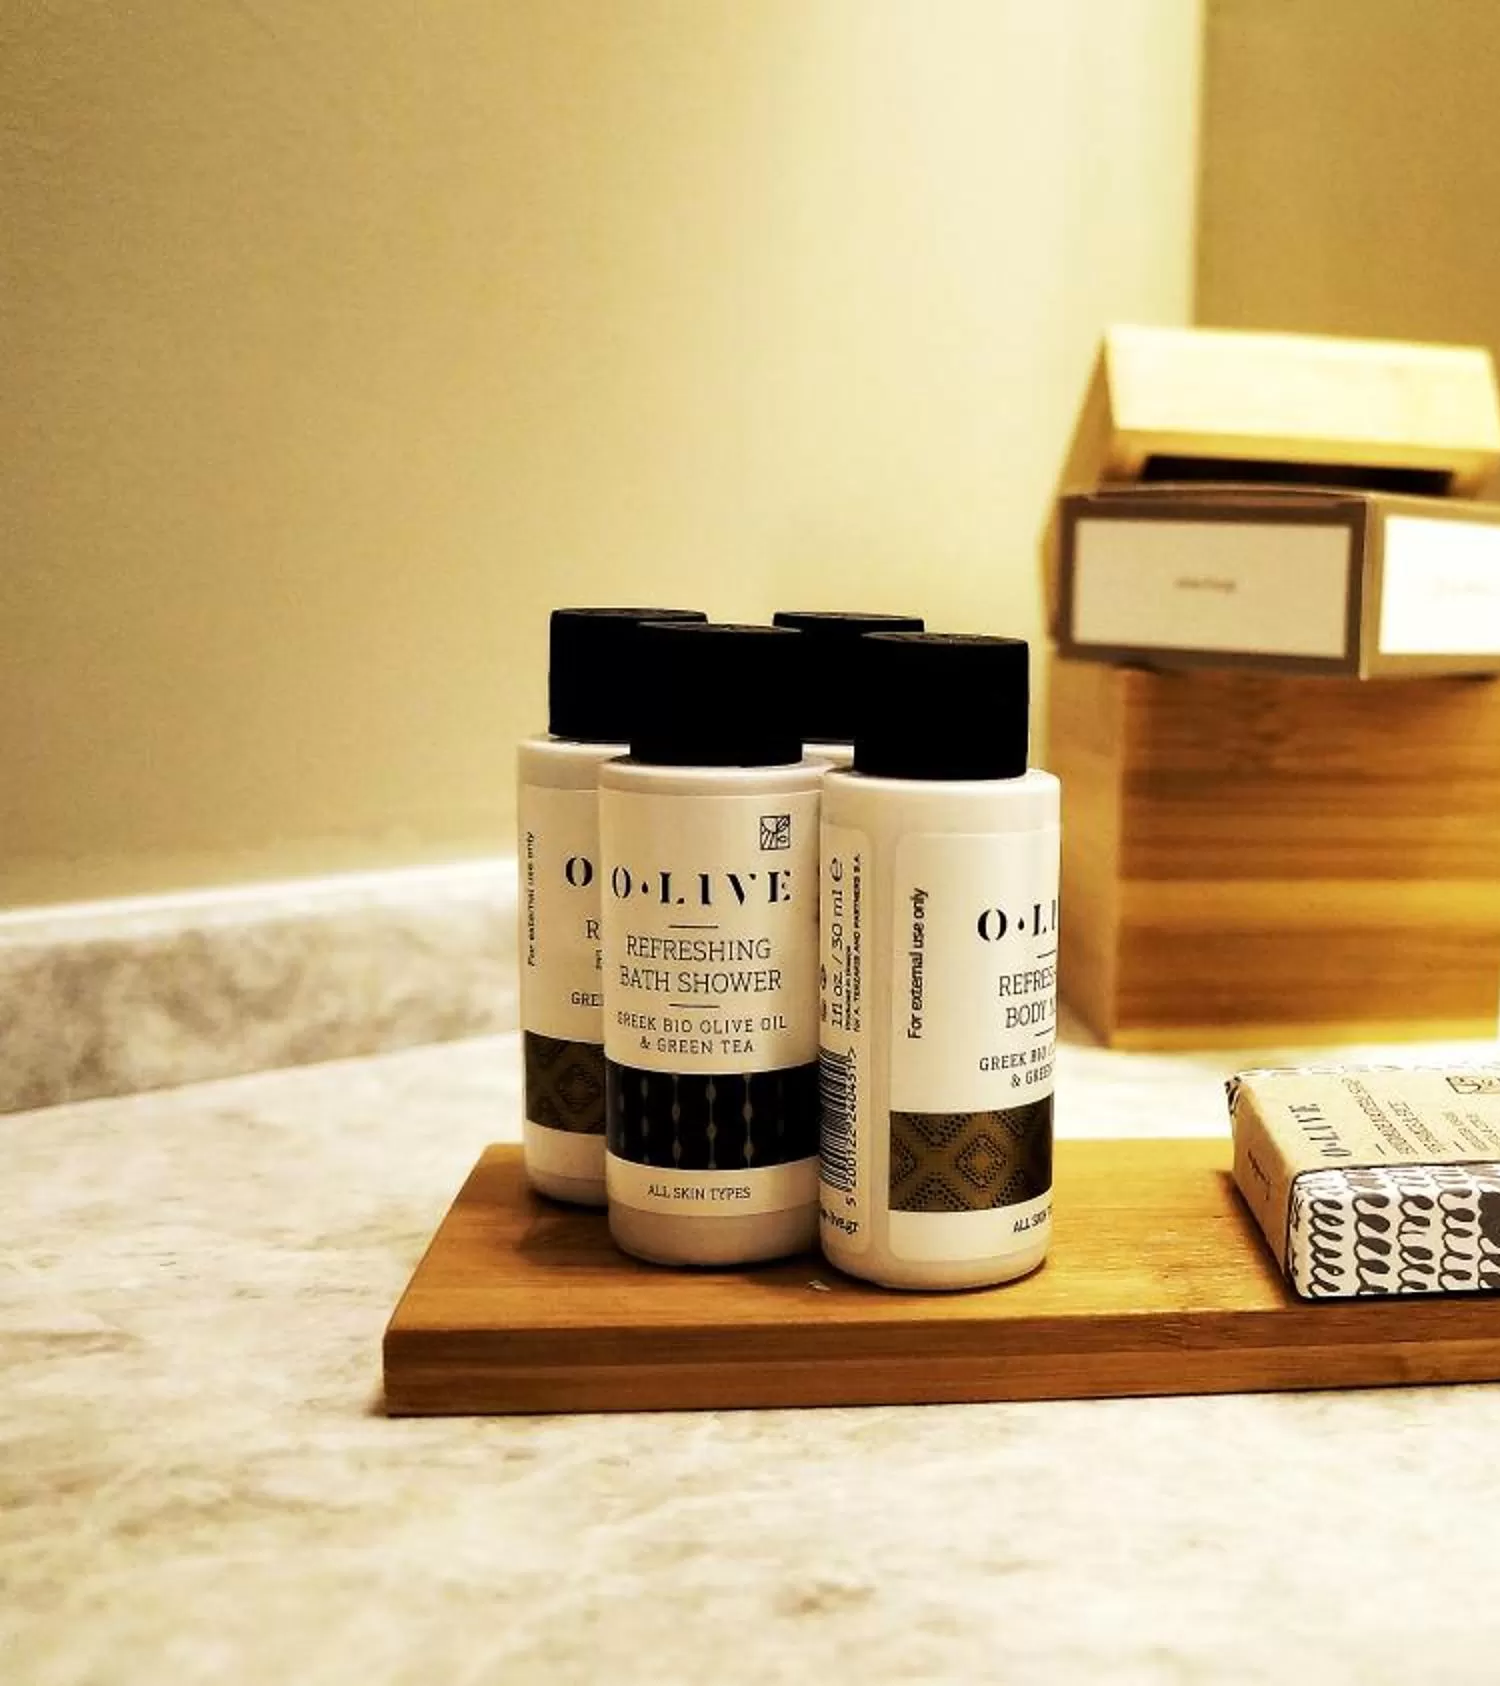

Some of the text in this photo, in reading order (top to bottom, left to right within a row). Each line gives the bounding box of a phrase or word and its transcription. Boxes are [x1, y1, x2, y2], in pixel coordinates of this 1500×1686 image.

[626, 934, 772, 962] REFRESHING
[831, 924, 843, 951] 30
[907, 887, 929, 1040] For external use only
[619, 965, 783, 995] BATH SHOWER
[617, 1010, 789, 1035] GREEK BIO OLIVE OIL
[1006, 1001, 1046, 1029] BODY
[639, 1035, 756, 1055] & GREEN TEA
[979, 1051, 1027, 1071] GREEK
[1010, 1072, 1021, 1089] &
[647, 1183, 753, 1201] ALL SKIN TYPES
